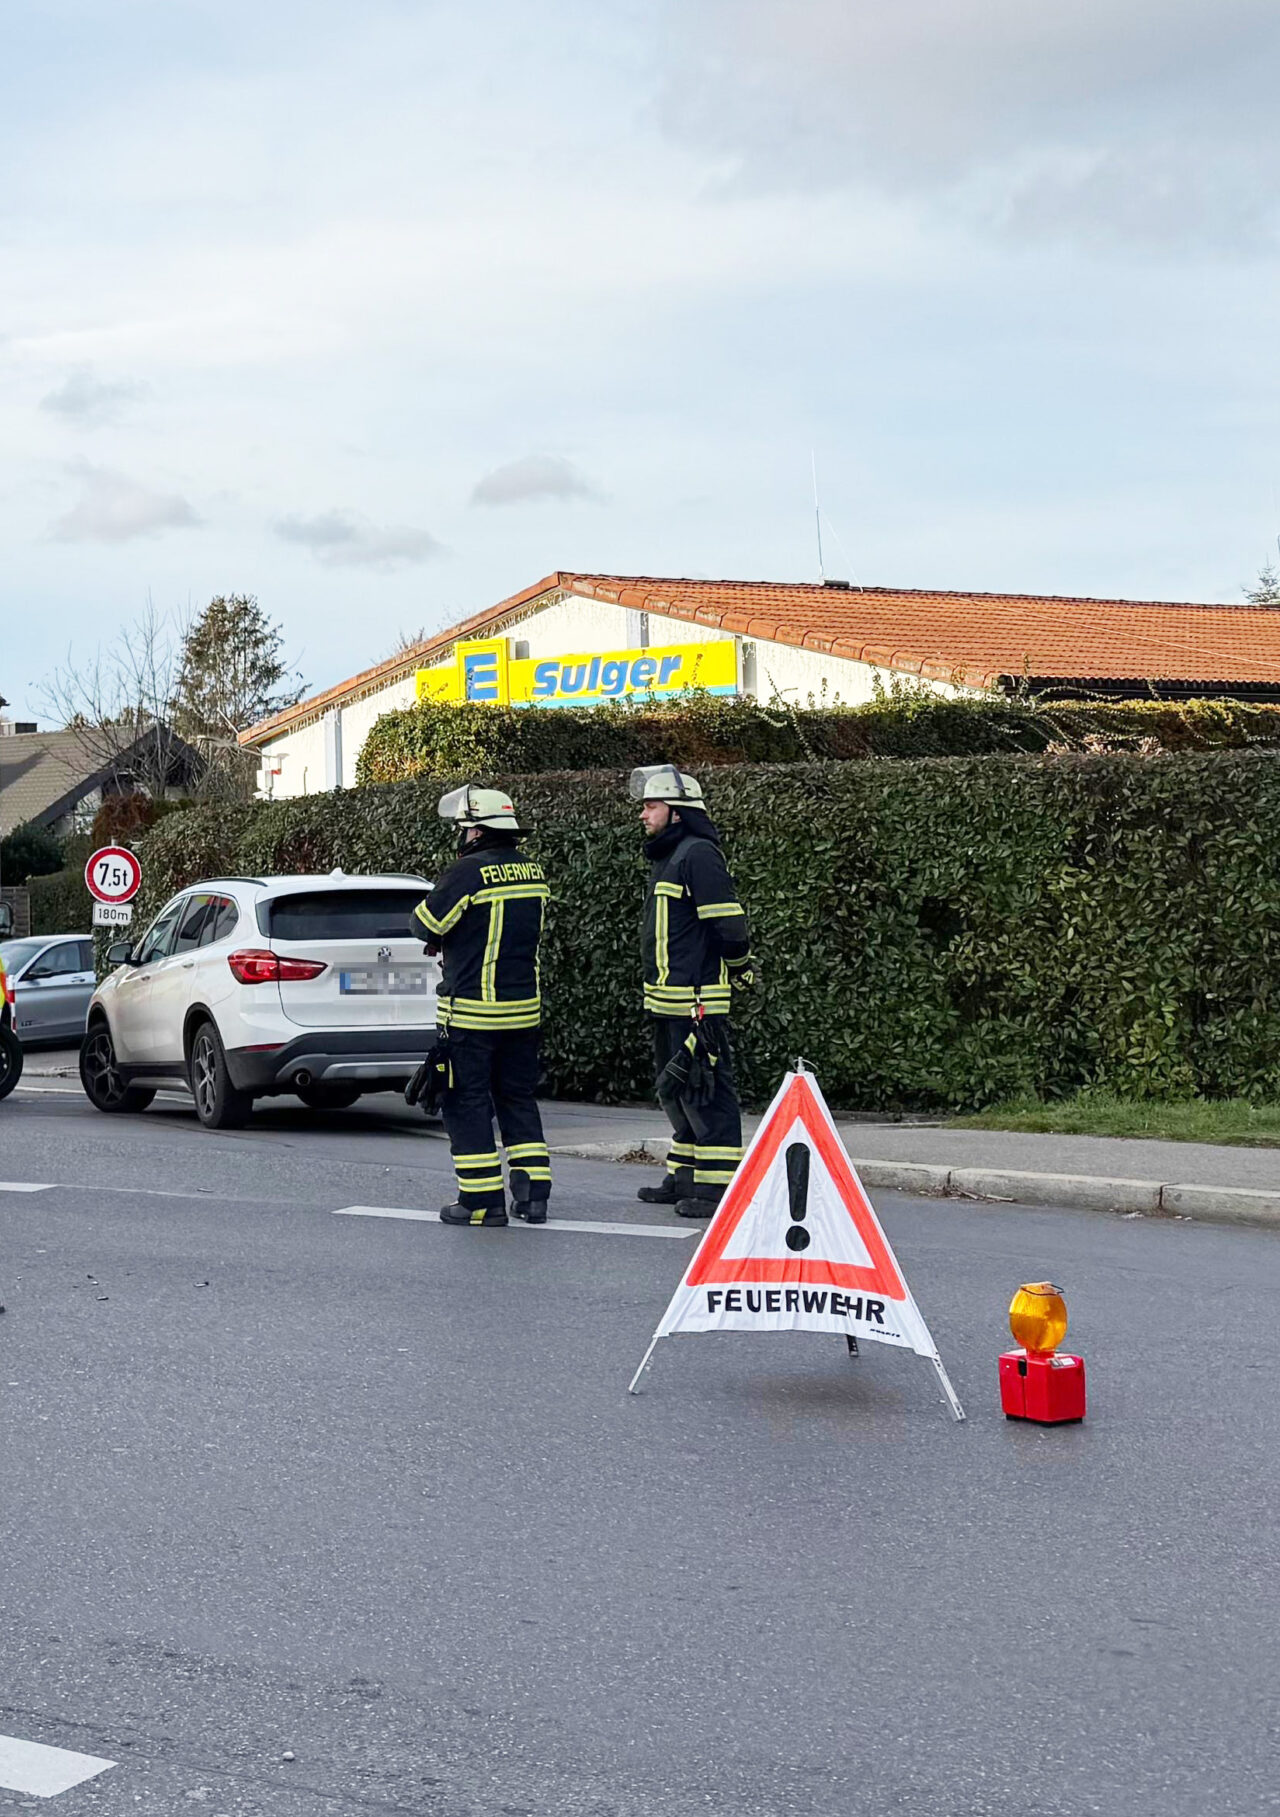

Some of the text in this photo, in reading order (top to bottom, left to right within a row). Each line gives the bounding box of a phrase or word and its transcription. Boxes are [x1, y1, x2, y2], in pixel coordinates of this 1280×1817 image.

[532, 653, 682, 696] Sulger
[480, 862, 545, 885] FEUERWEH
[98, 908, 128, 920] 180m
[707, 1289, 885, 1325] FEUERWEHR
